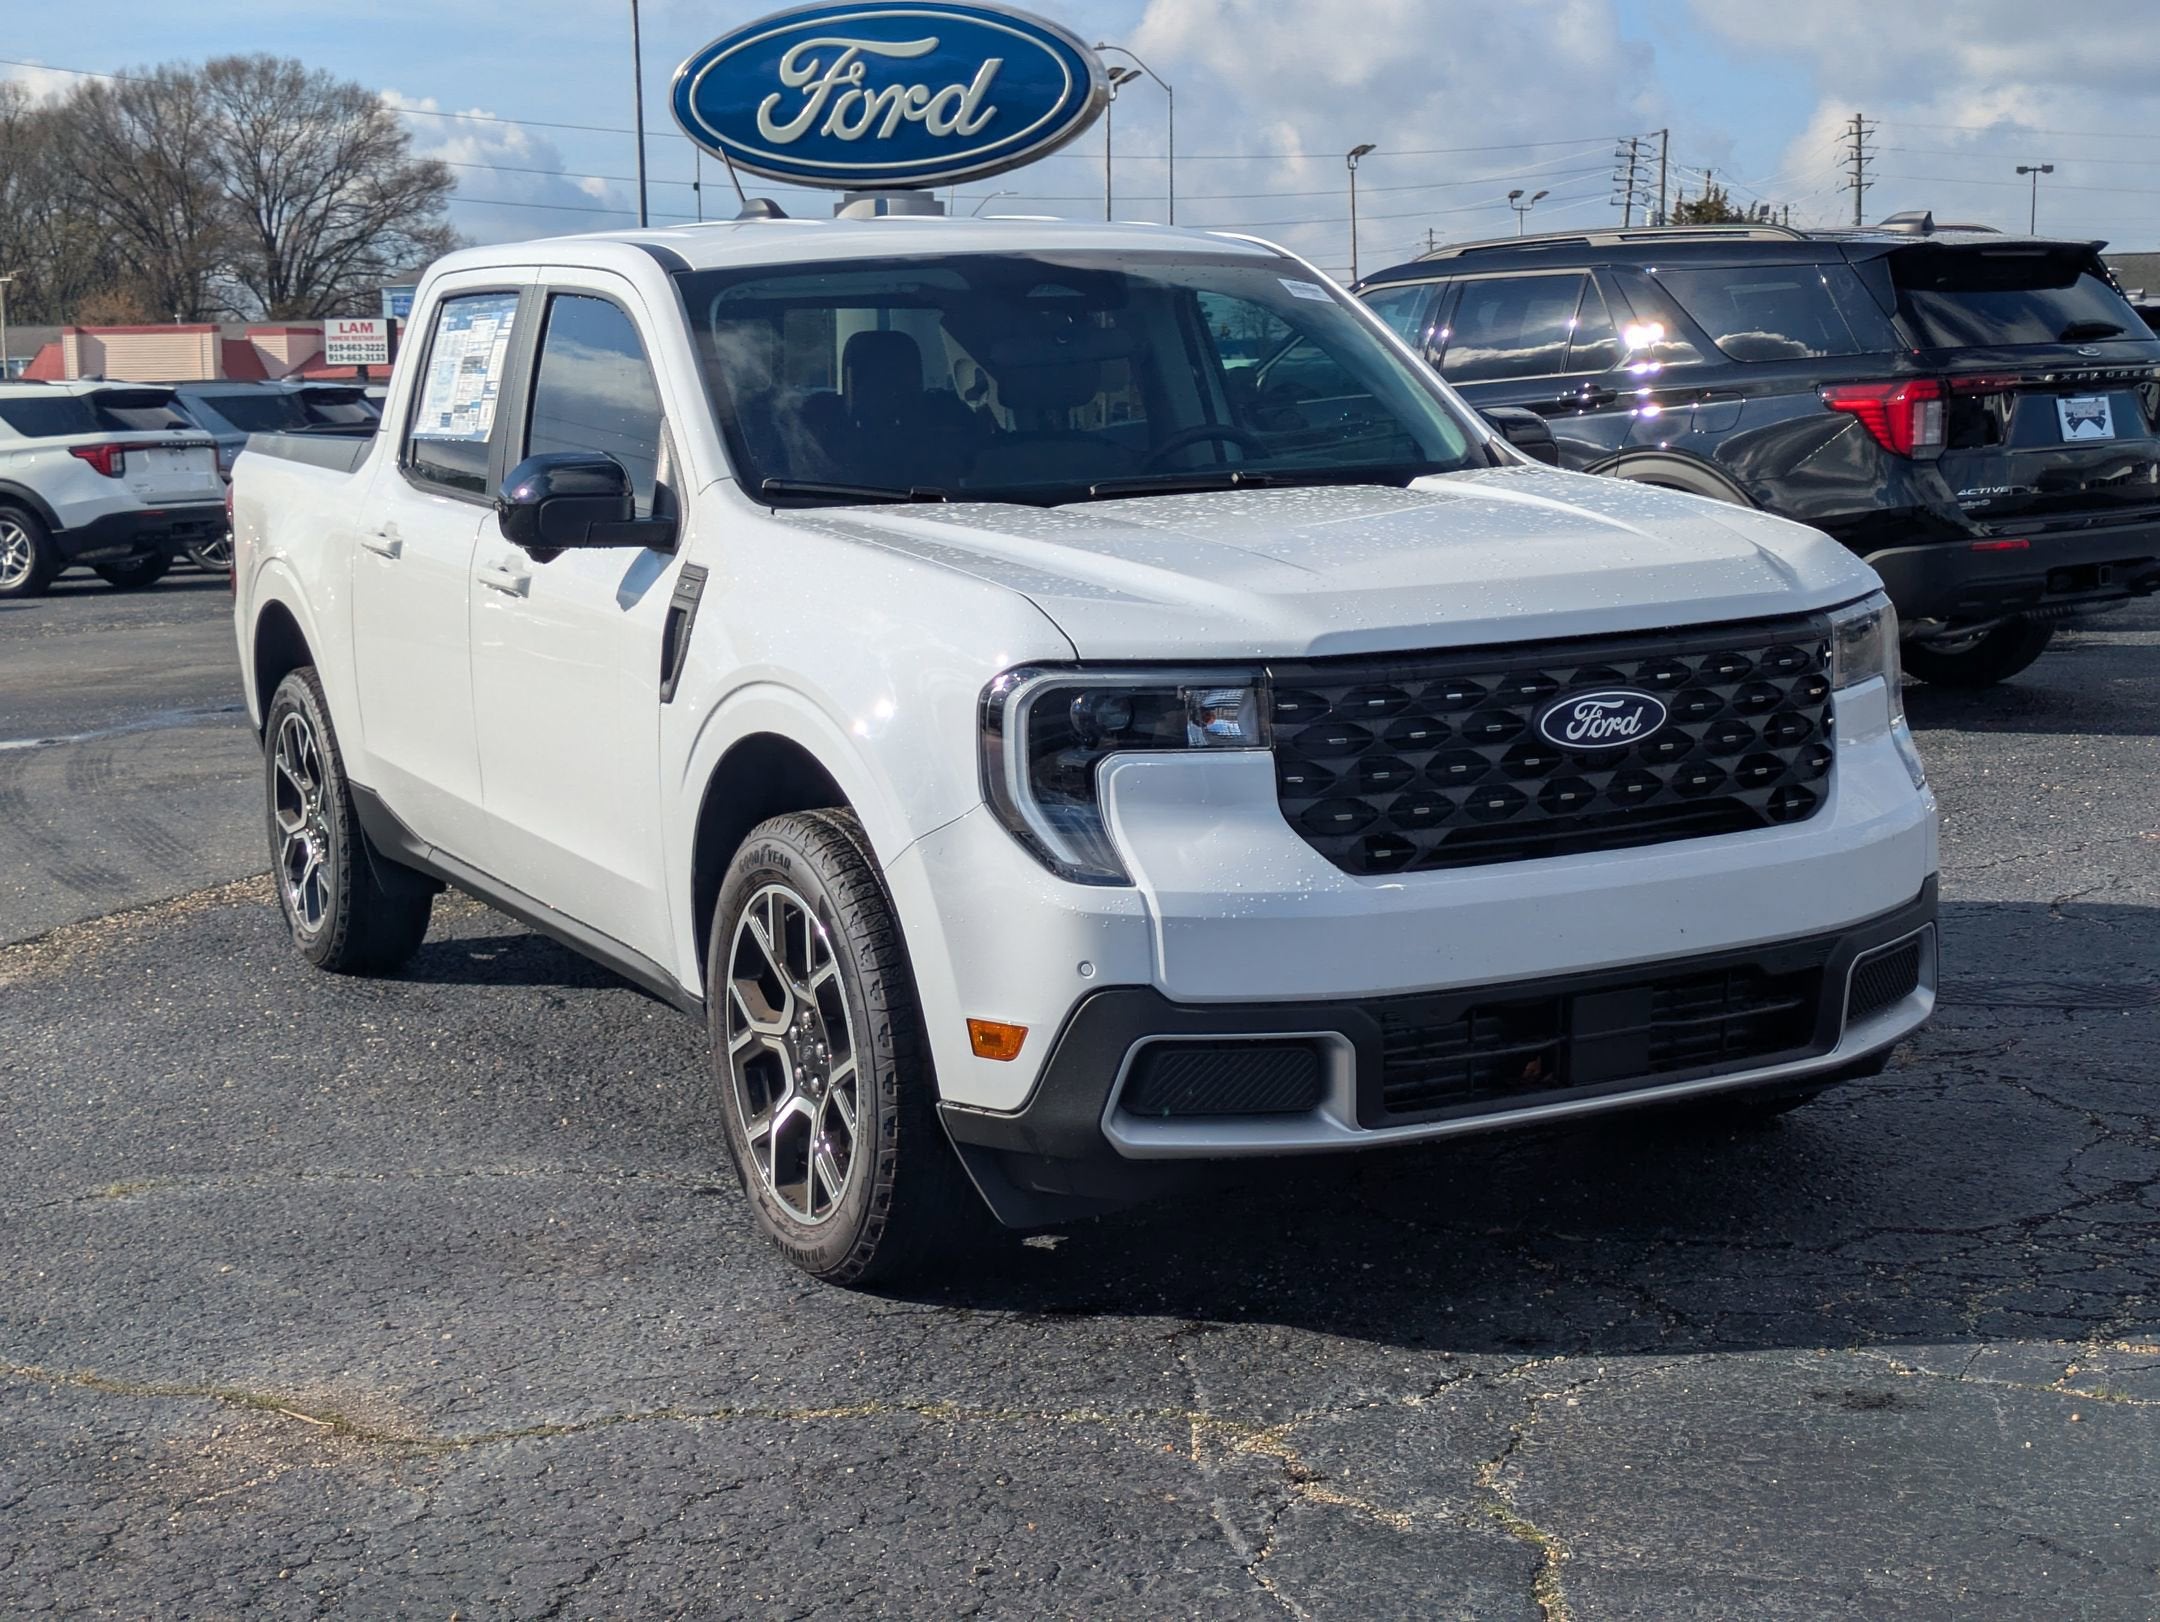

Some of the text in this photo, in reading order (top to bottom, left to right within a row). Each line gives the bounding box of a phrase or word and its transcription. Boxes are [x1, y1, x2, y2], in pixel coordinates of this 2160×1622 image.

[756, 36, 1005, 144] Ford
[339, 322, 374, 334] LAM
[328, 344, 386, 352] 919-663-3222
[1566, 700, 1644, 740] Ford
